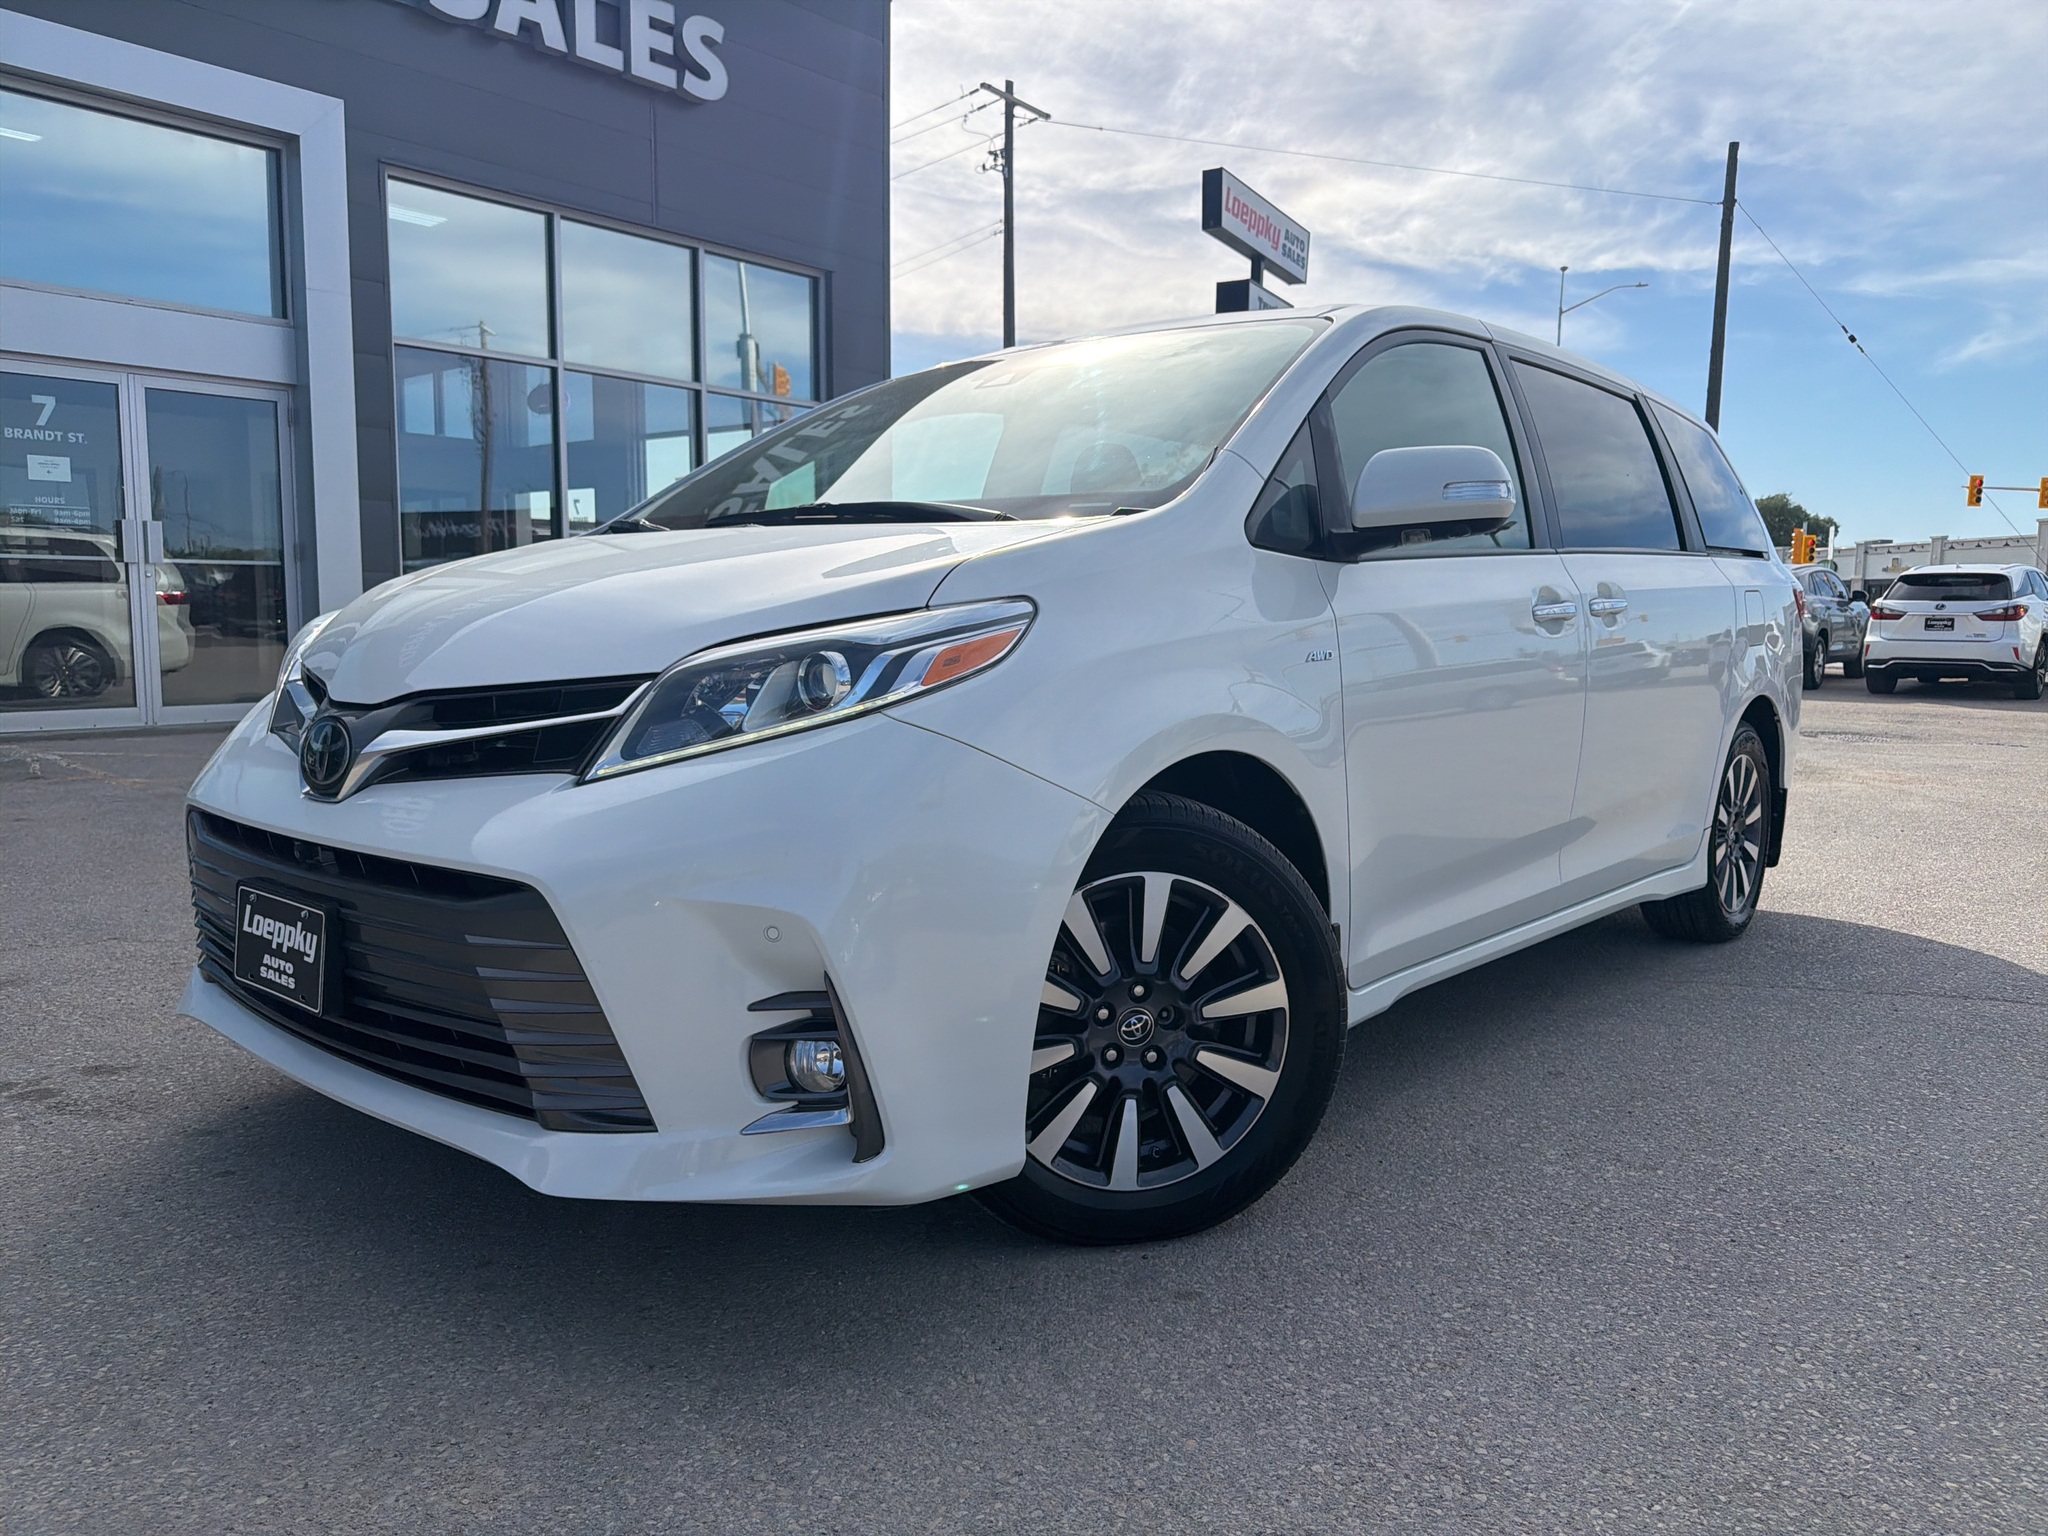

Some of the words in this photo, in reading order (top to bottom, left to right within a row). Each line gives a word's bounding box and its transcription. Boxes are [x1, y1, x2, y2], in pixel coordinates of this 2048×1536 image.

[428, 0, 729, 101] ALES
[1224, 186, 1282, 252] Loeppky
[1284, 228, 1305, 253] AUTO
[1281, 243, 1306, 270] SALES
[31, 394, 56, 426] 7
[4, 427, 63, 442] BRANDT
[68, 432, 88, 444] ST.
[34, 496, 66, 505] HOURS
[1305, 650, 1333, 662] AWD
[242, 904, 318, 964] Loeppky
[262, 953, 294, 975] AUTO
[260, 965, 296, 989] SALES
